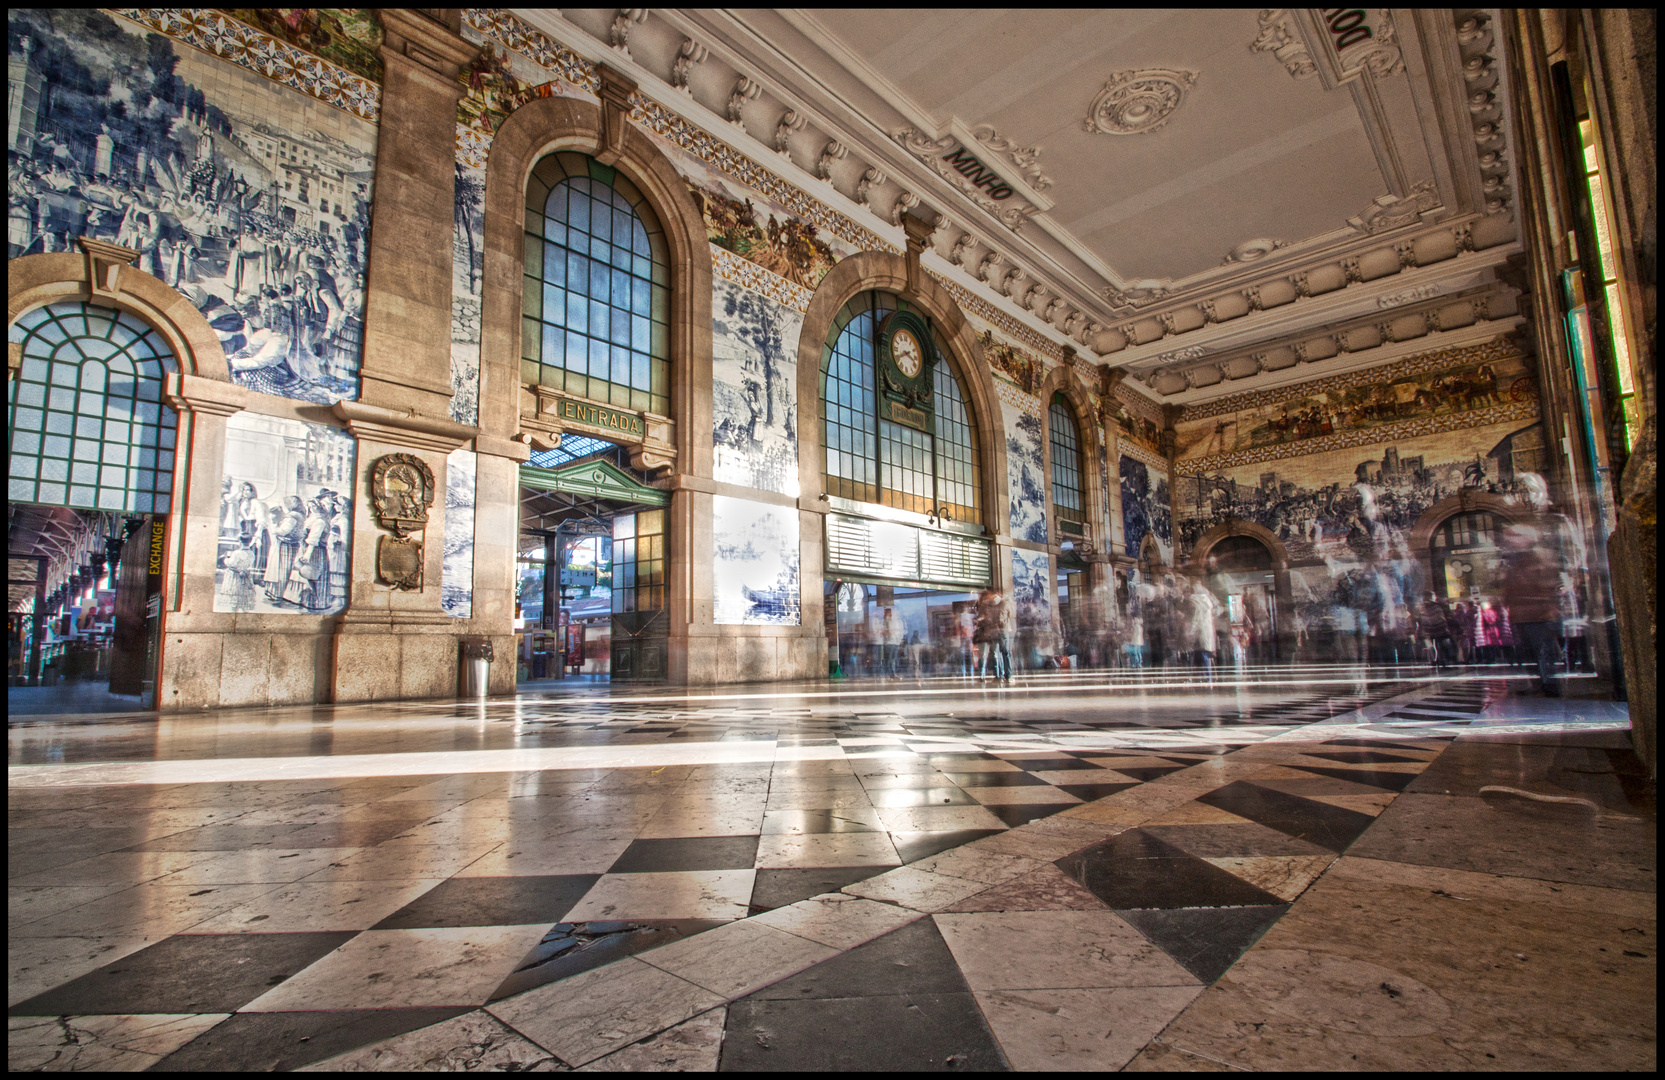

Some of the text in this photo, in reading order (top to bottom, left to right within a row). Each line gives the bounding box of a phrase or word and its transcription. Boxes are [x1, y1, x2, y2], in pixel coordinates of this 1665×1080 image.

[943, 147, 1013, 200] MINHO
[564, 402, 639, 433] ENTRADA
[149, 521, 164, 575] EXCHANGE
